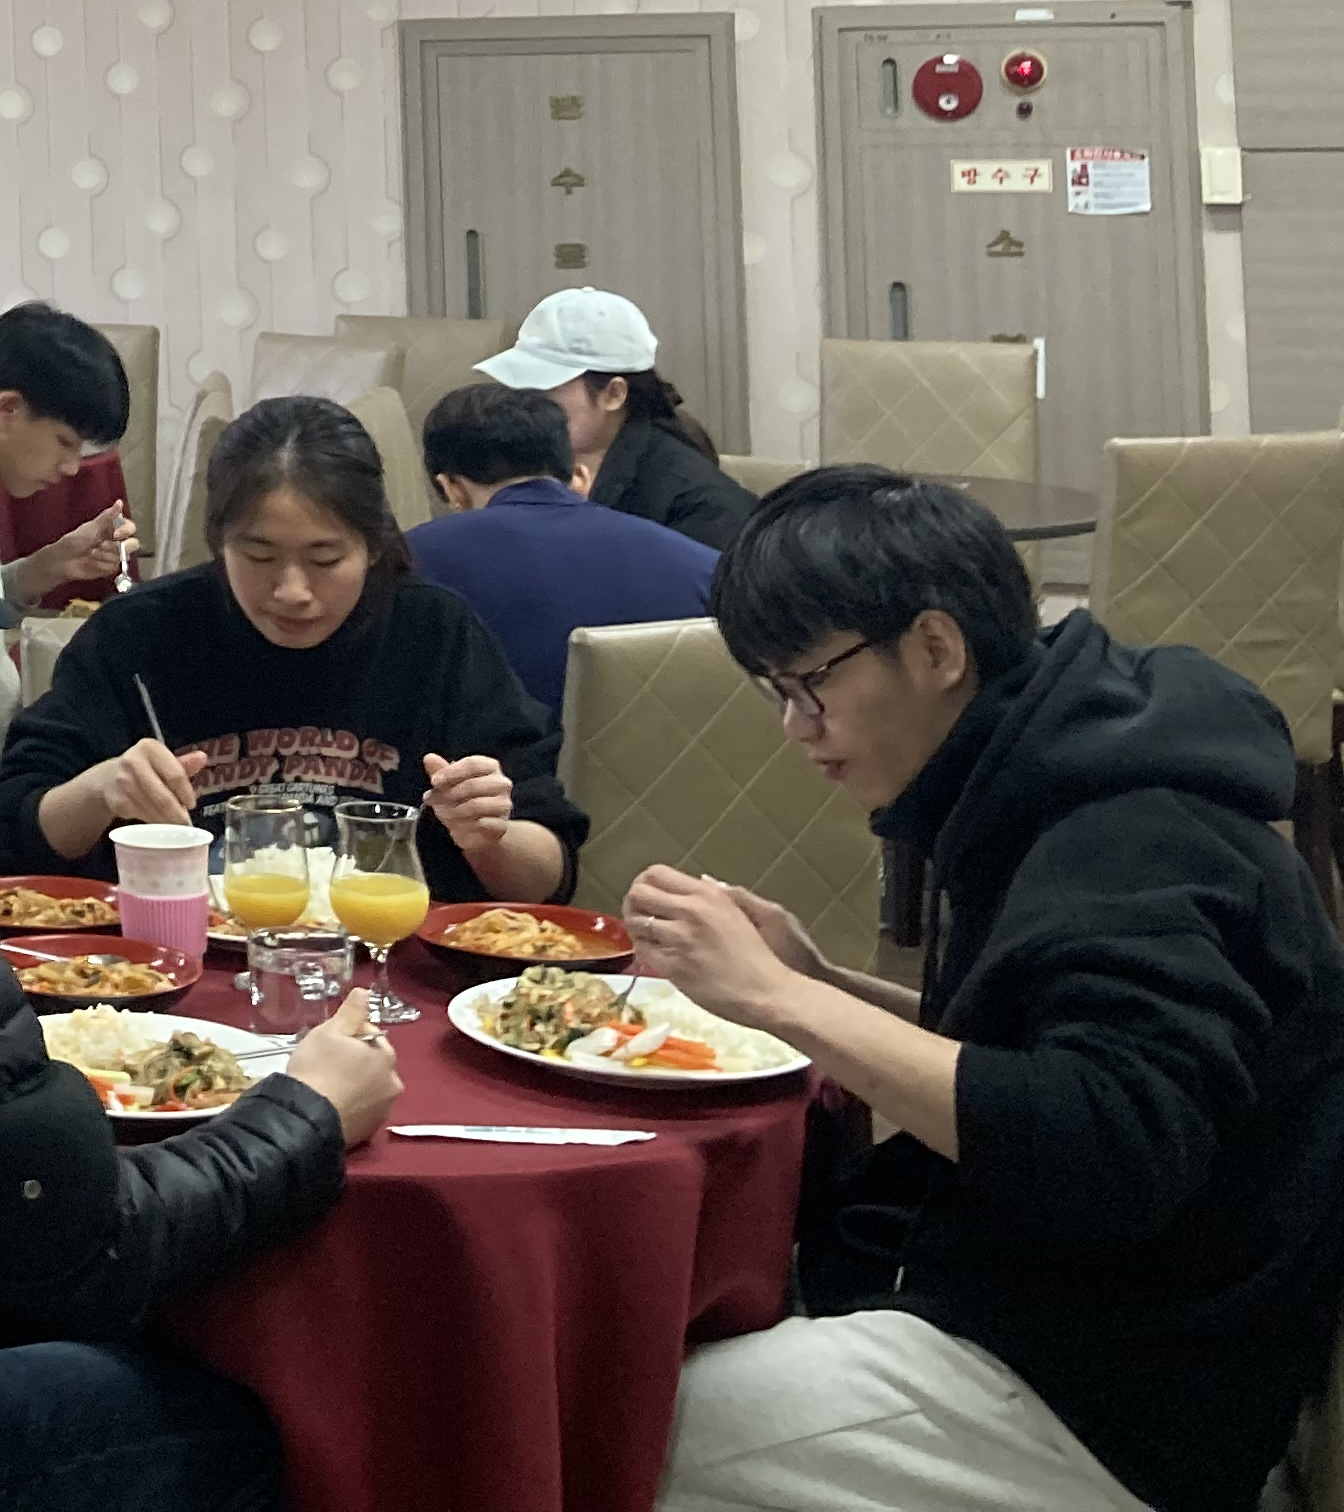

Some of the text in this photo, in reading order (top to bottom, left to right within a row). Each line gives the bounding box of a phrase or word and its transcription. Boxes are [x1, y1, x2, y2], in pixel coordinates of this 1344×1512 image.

[246, 725, 359, 760] WORLD
[363, 738, 400, 771] OF
[282, 755, 384, 794] PANDA
